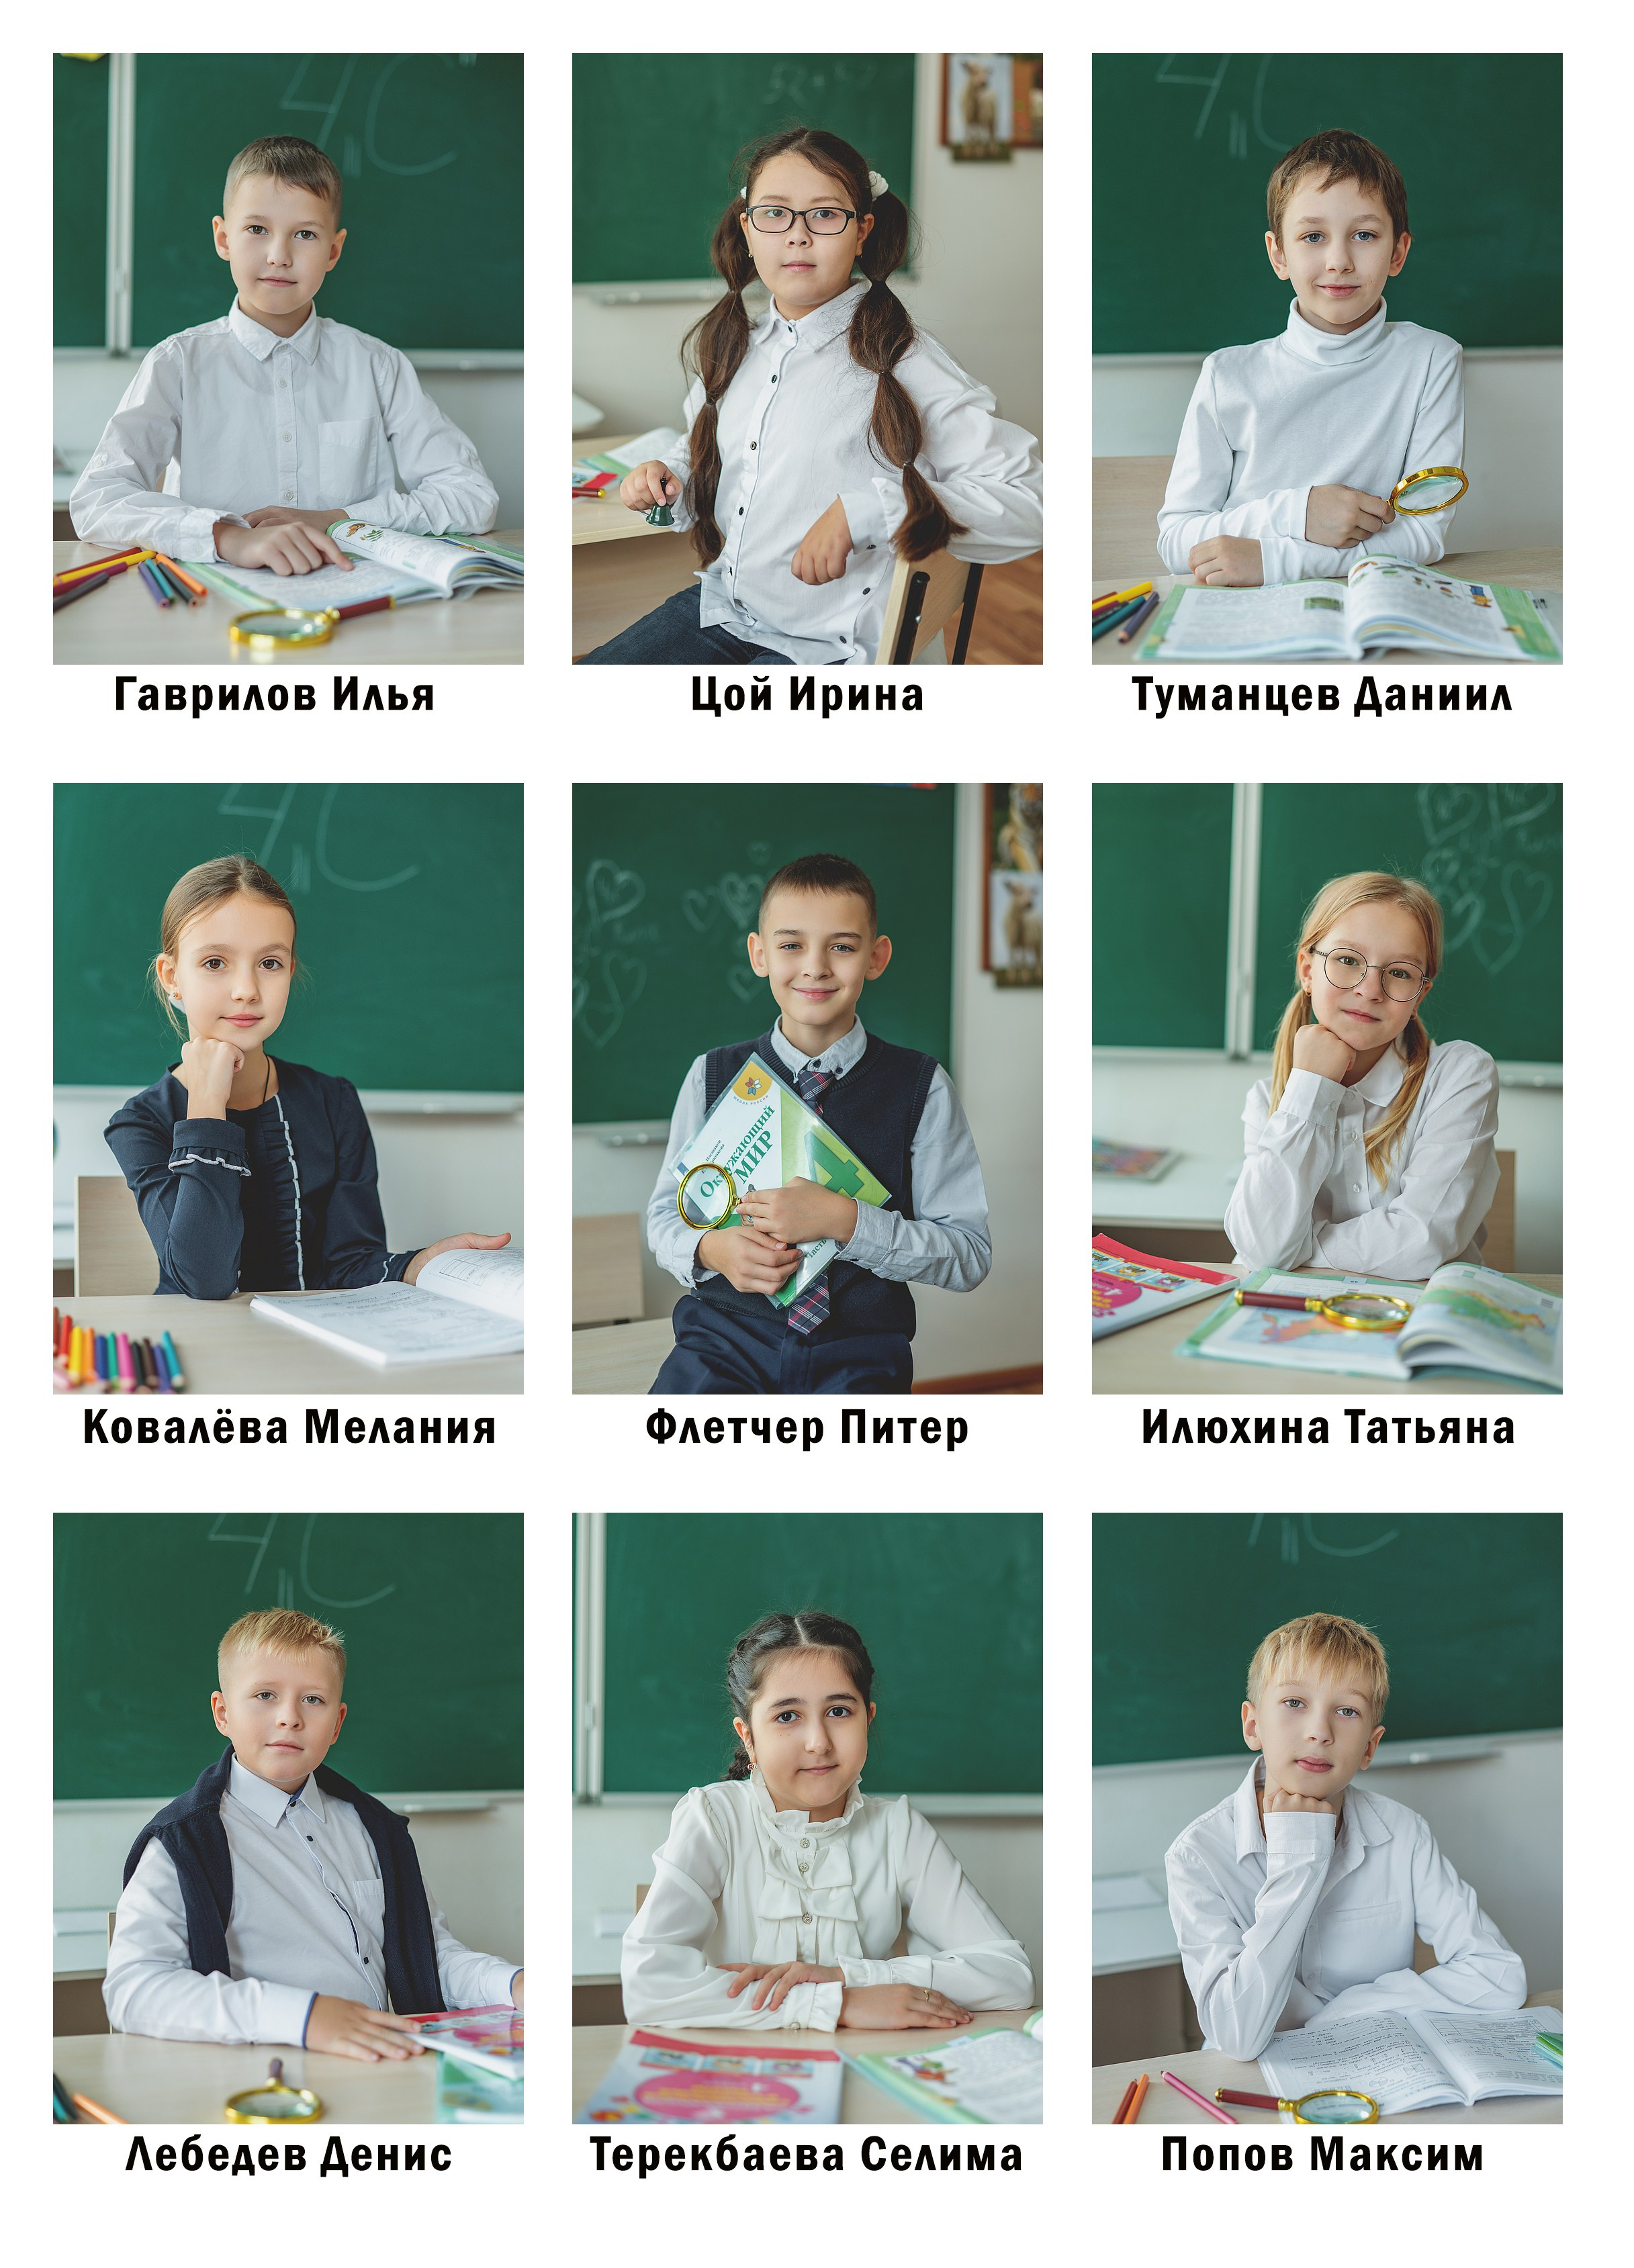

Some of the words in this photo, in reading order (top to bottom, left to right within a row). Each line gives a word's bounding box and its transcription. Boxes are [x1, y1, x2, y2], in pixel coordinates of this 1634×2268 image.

[733, 1095, 748, 1105] ШКОЛА
[750, 1094, 769, 1105] РОССИИ
[733, 1130, 774, 1184] МИР
[803, 1131, 864, 1198] 4
[804, 1238, 827, 1259] Часть
